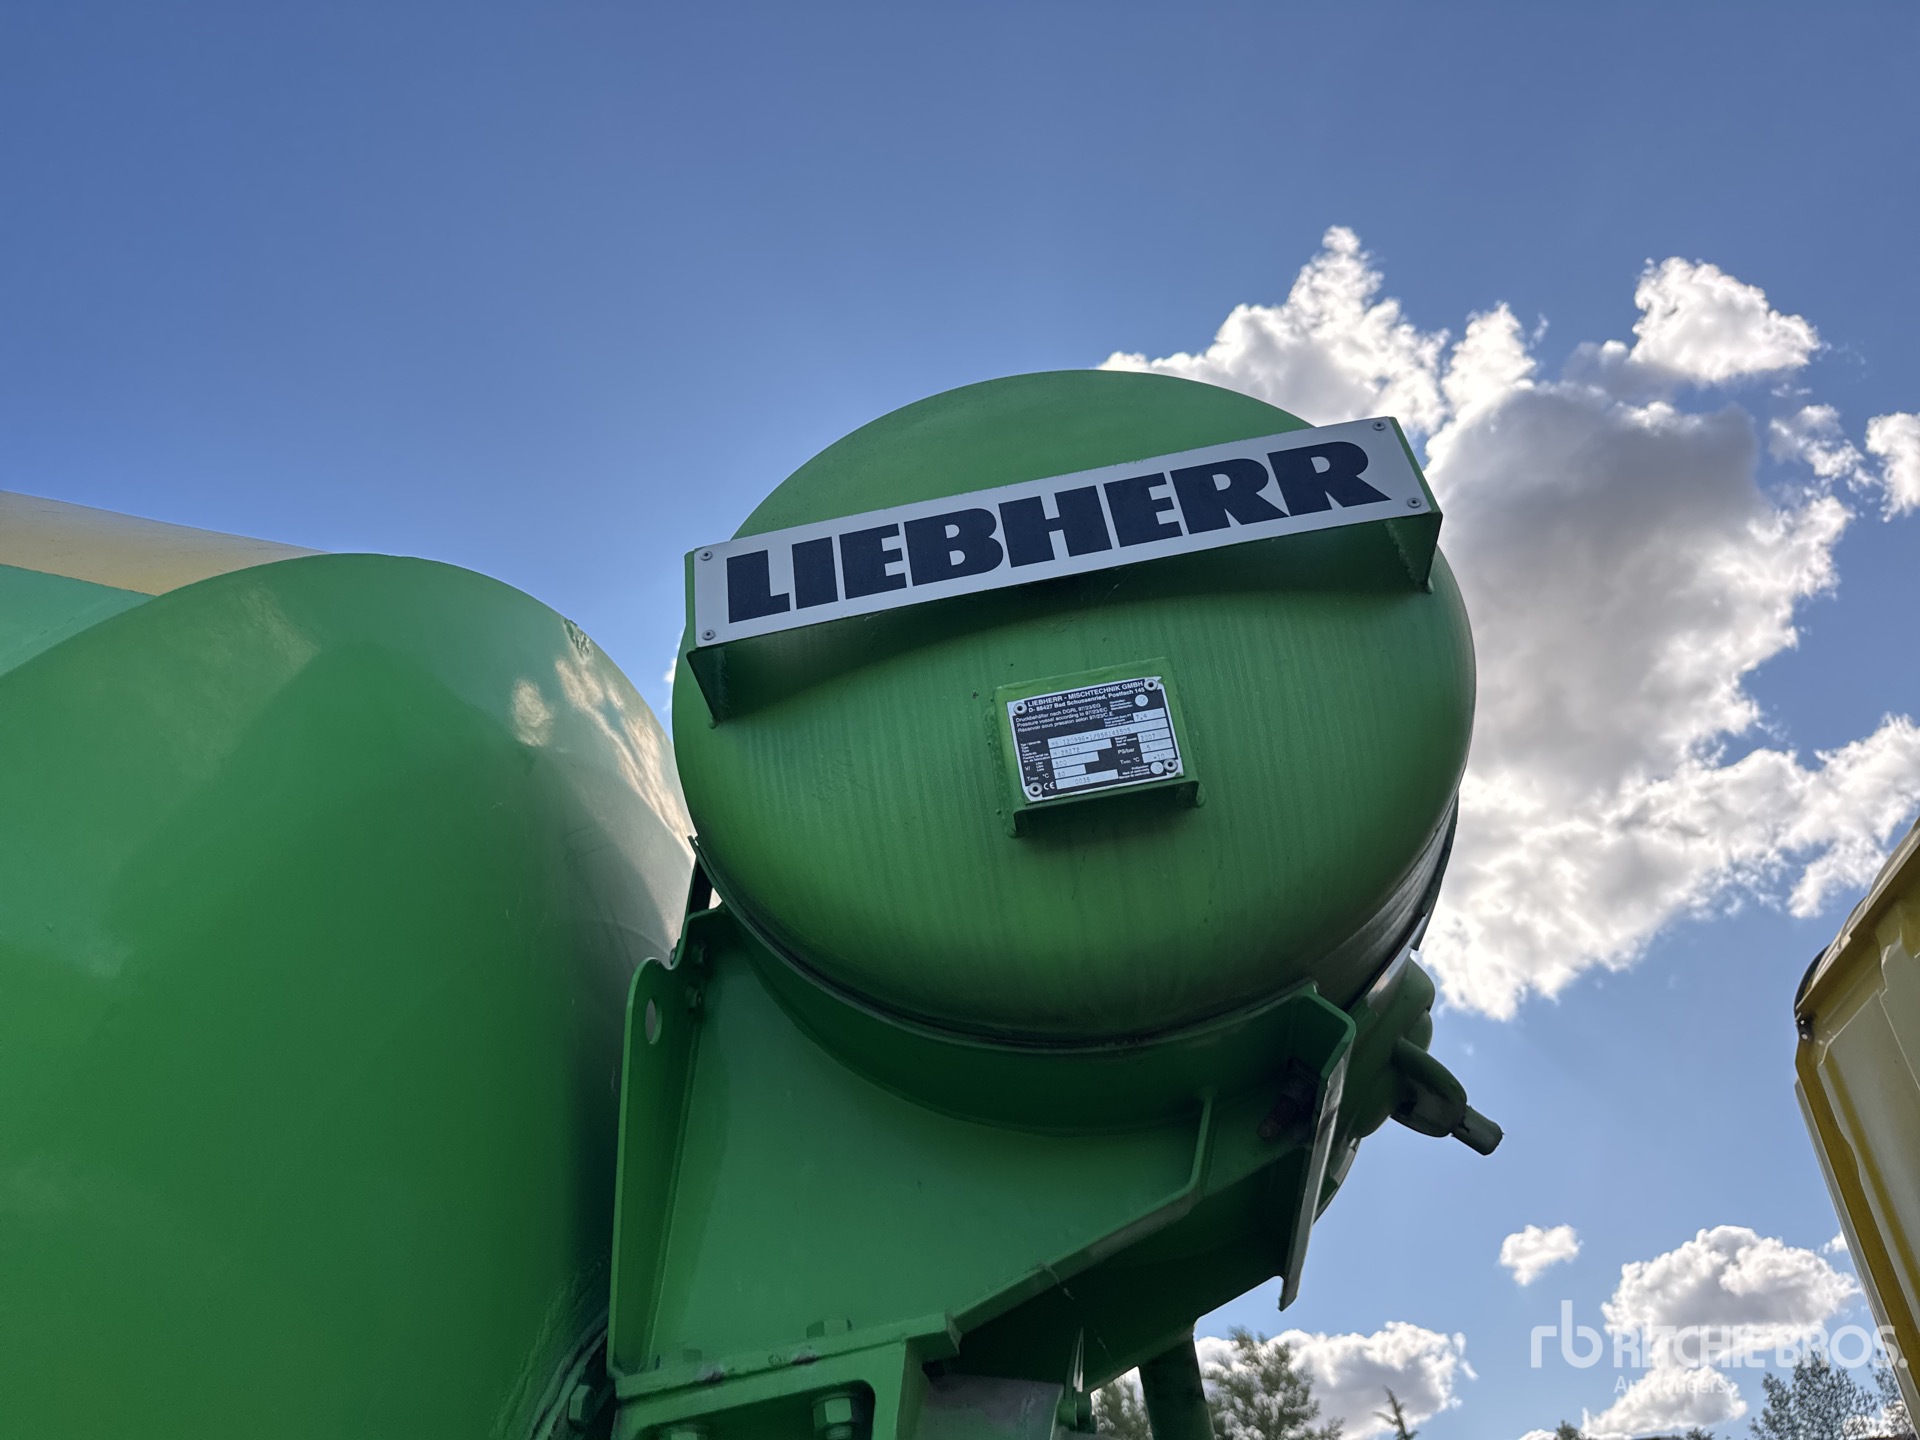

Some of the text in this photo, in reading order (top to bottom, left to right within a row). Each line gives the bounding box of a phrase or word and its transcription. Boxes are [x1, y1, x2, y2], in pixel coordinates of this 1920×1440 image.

[727, 441, 1391, 623] LIEBHERR
[1027, 696, 1063, 707] LIEBHERR
[1068, 685, 1121, 699] MISCHTECHNIK
[1121, 681, 1143, 690] GMBH
[1067, 694, 1107, 706] Schussenried,
[1108, 690, 1134, 698] Postfach
